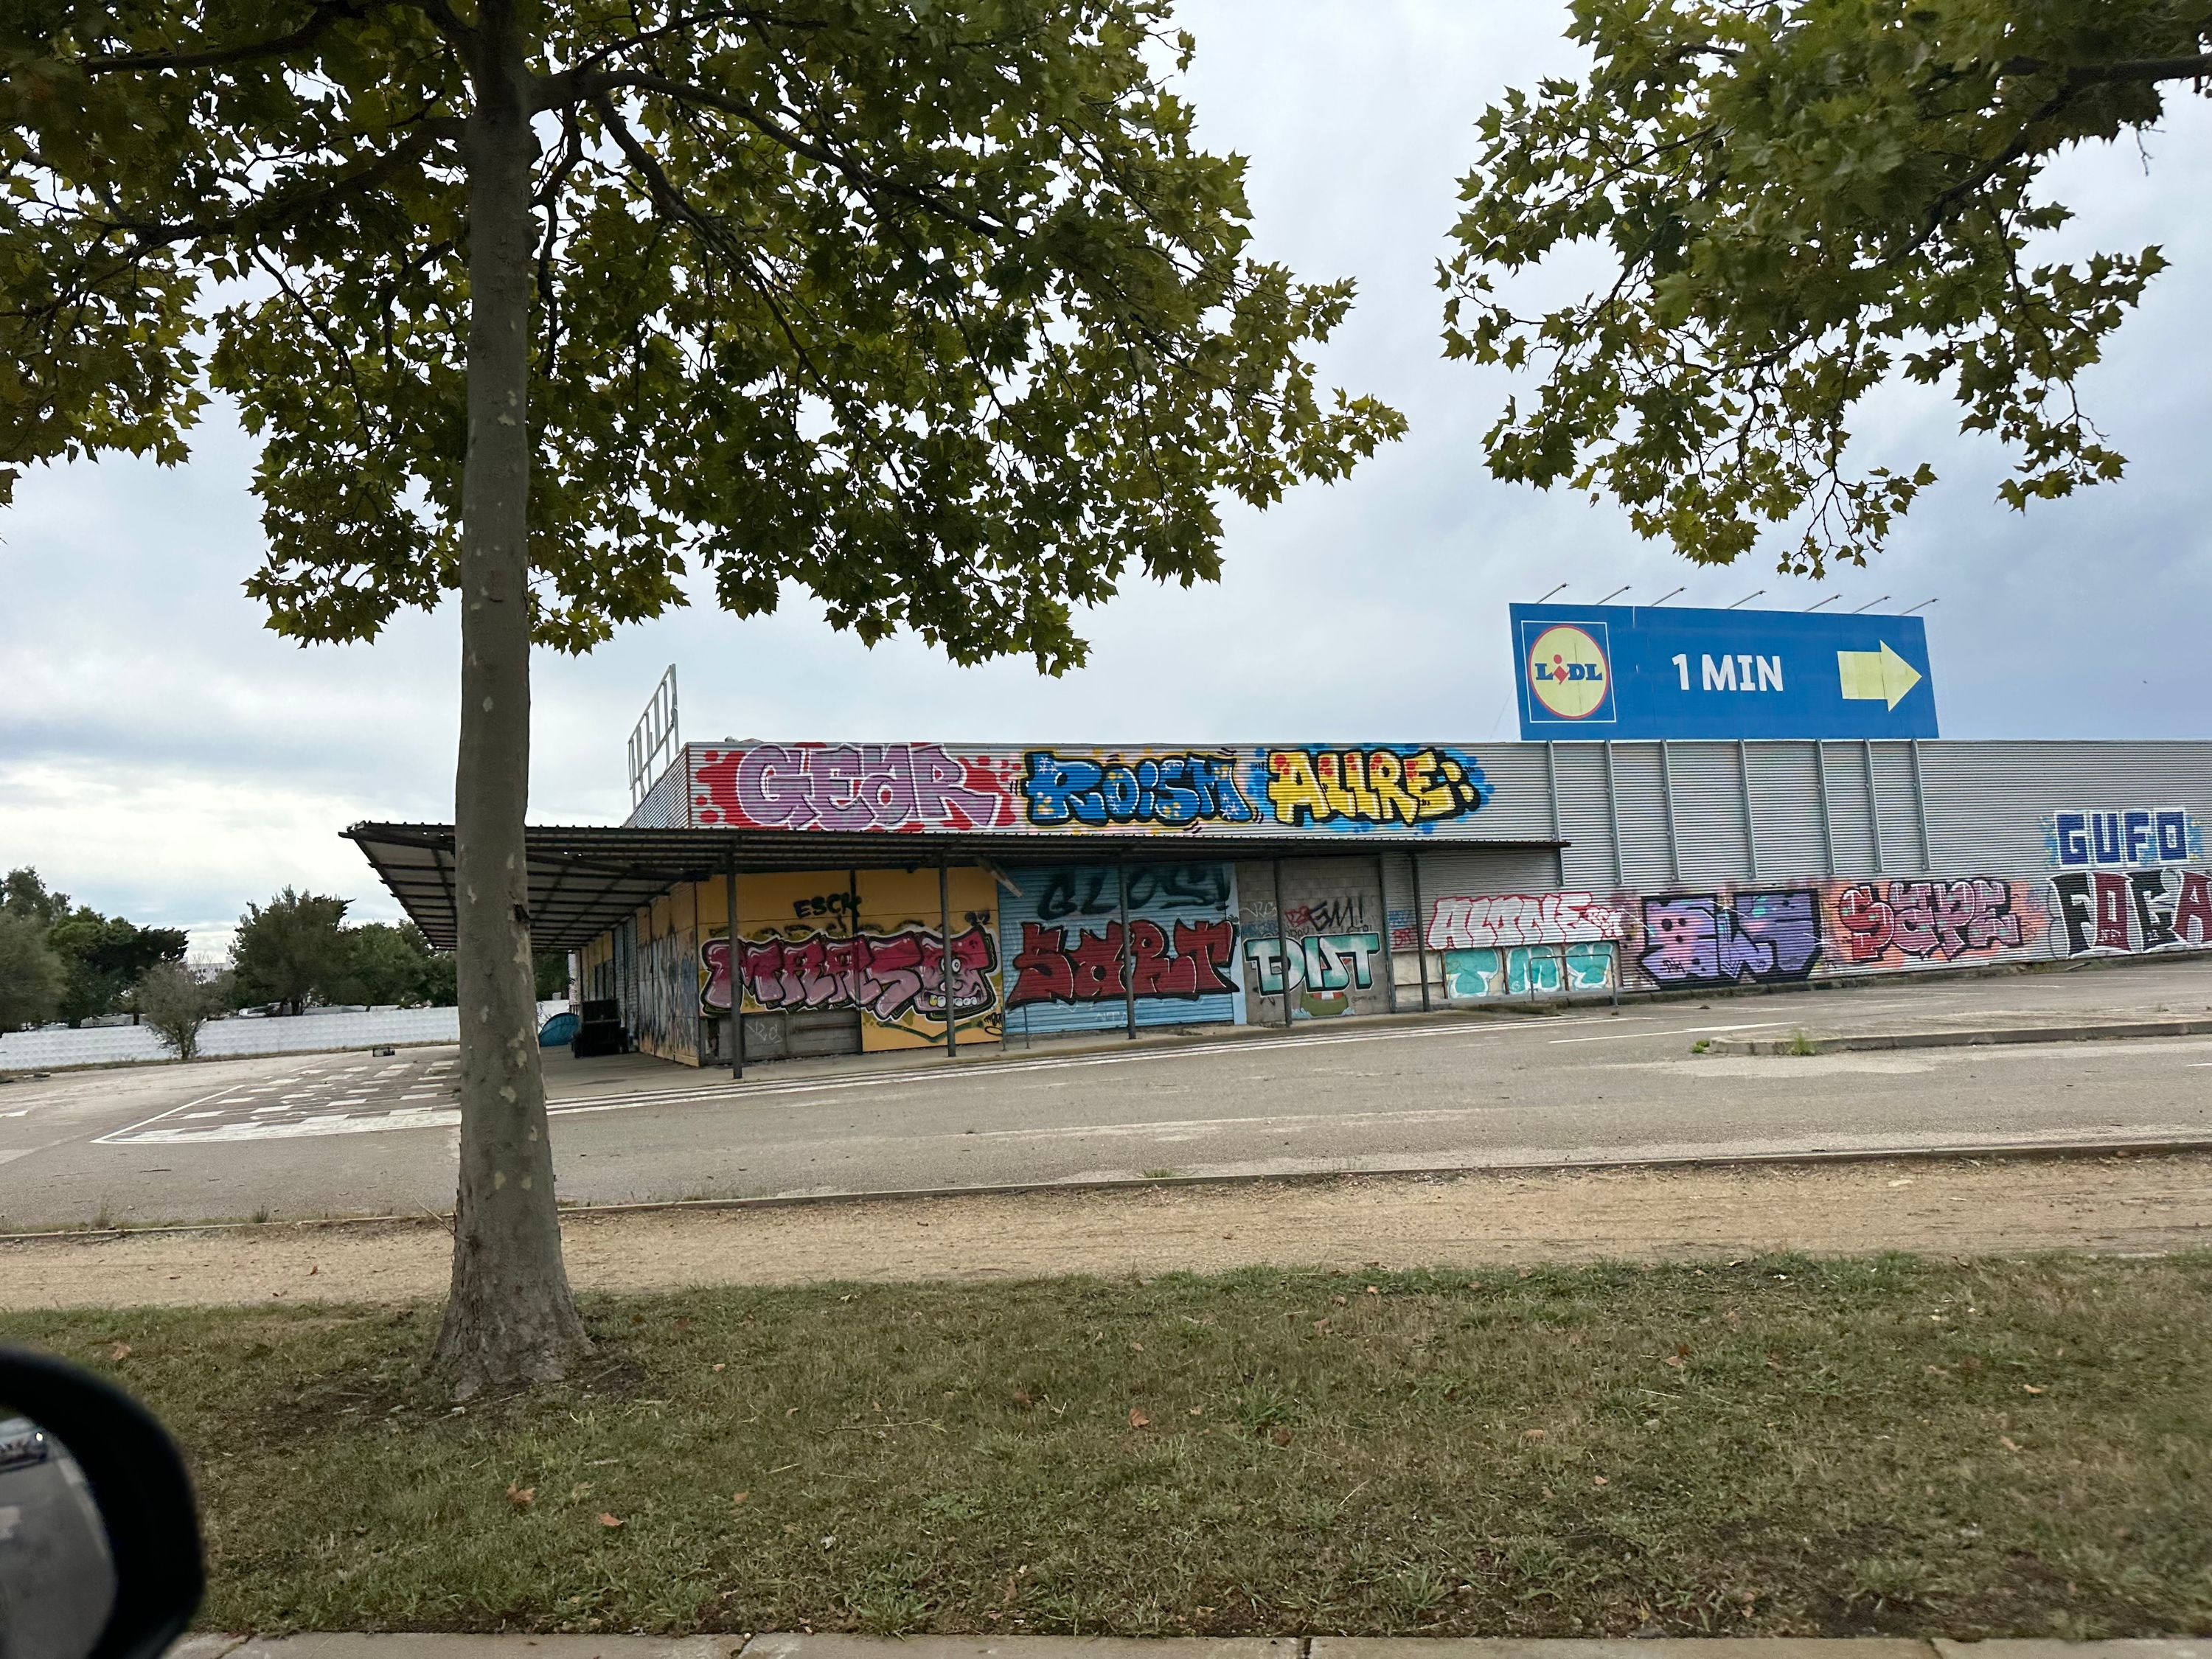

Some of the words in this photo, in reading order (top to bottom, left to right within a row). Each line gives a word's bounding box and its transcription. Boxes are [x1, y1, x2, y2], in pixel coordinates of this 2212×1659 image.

[1672, 653, 1690, 691] 1
[1702, 654, 1784, 692] MIN
[2054, 807, 2191, 869] GUFO
